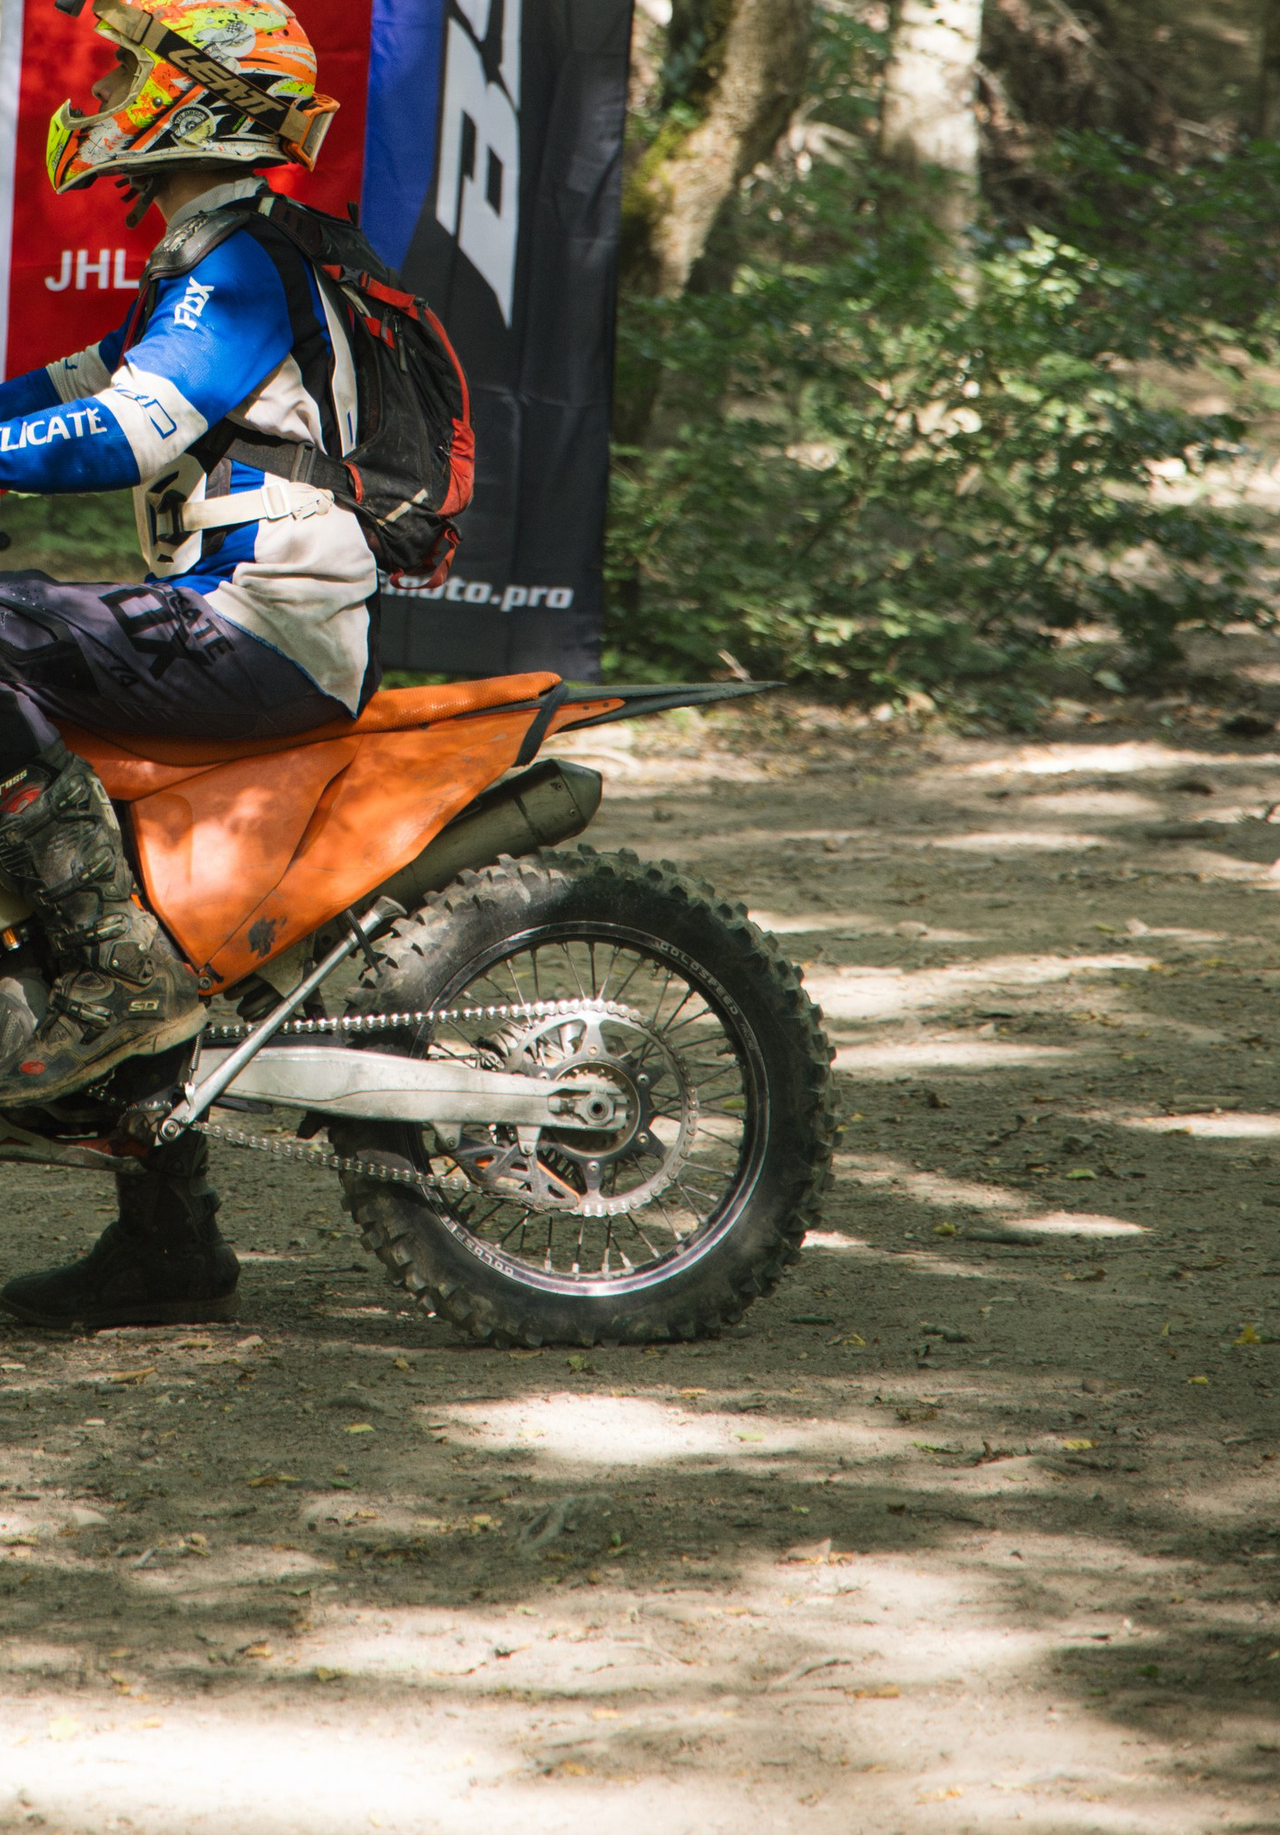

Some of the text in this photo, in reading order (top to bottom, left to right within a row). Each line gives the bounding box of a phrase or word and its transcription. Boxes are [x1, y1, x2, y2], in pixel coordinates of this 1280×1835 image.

[168, 49, 287, 115] LEATT
[44, 248, 150, 292] JHL
[174, 276, 215, 330] FOX
[660, 942, 739, 1015] GOLDSPEED
